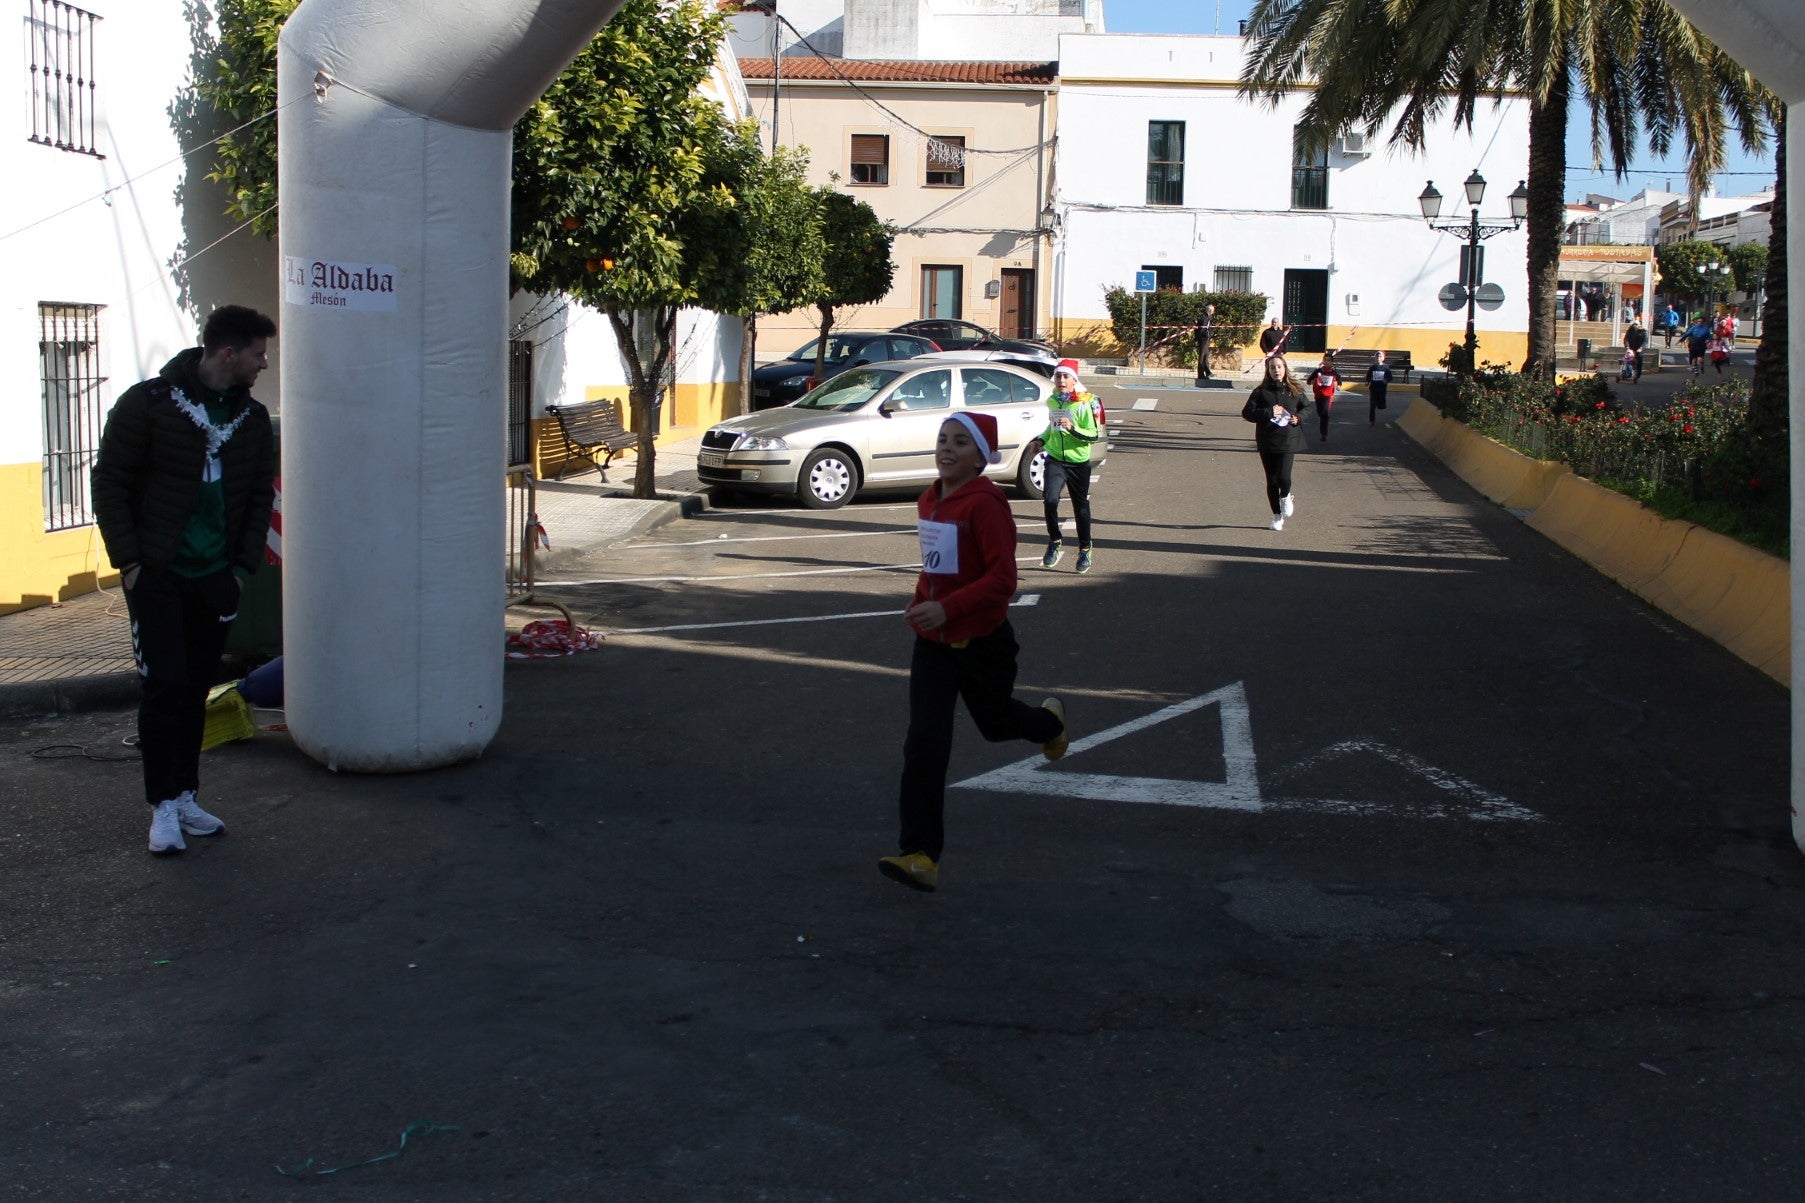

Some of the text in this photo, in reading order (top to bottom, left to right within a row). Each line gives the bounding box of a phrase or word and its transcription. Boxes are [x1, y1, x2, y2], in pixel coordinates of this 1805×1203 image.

[1600, 247, 1643, 257] TOSTADAS
[287, 258, 395, 293] La Aldaba
[310, 292, 347, 307] Mesón
[924, 550, 941, 569] 10
